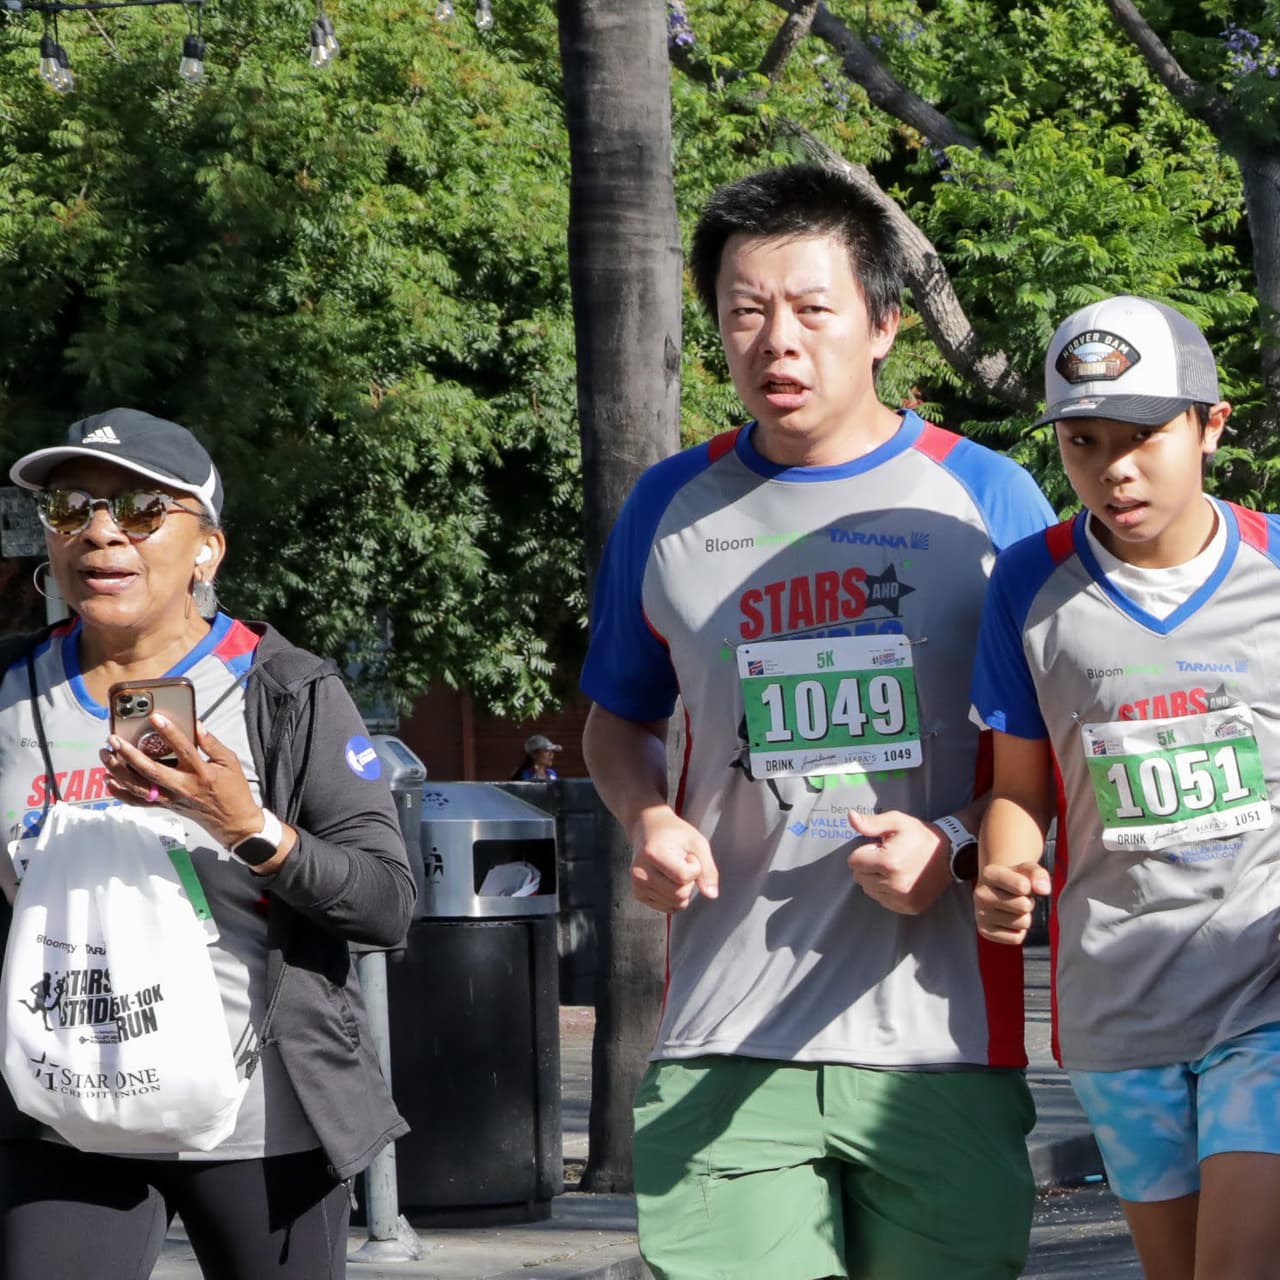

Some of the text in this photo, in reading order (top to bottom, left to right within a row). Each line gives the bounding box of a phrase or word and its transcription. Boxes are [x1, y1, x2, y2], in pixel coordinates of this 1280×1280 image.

[1063, 333, 1129, 359] HOOVER DAM
[826, 528, 909, 548] TARANA
[740, 567, 868, 640] STARS
[872, 582, 899, 599] AND
[817, 650, 834, 669] 5K
[1176, 660, 1233, 673] TARANA
[761, 675, 906, 744] 1049
[1118, 687, 1208, 721] STARS
[1157, 729, 1177, 746] 5K
[766, 759, 795, 772] DRINK
[884, 749, 912, 762] 1049
[27, 767, 115, 807] STAR
[1107, 747, 1251, 819] 1051
[811, 818, 848, 828] VALLE
[811, 829, 859, 840] FOUNDA
[1118, 834, 1146, 845] DRINK
[1234, 811, 1262, 826] 1051
[117, 1007, 158, 1042] RUN
[61, 1067, 110, 1089] STAR
